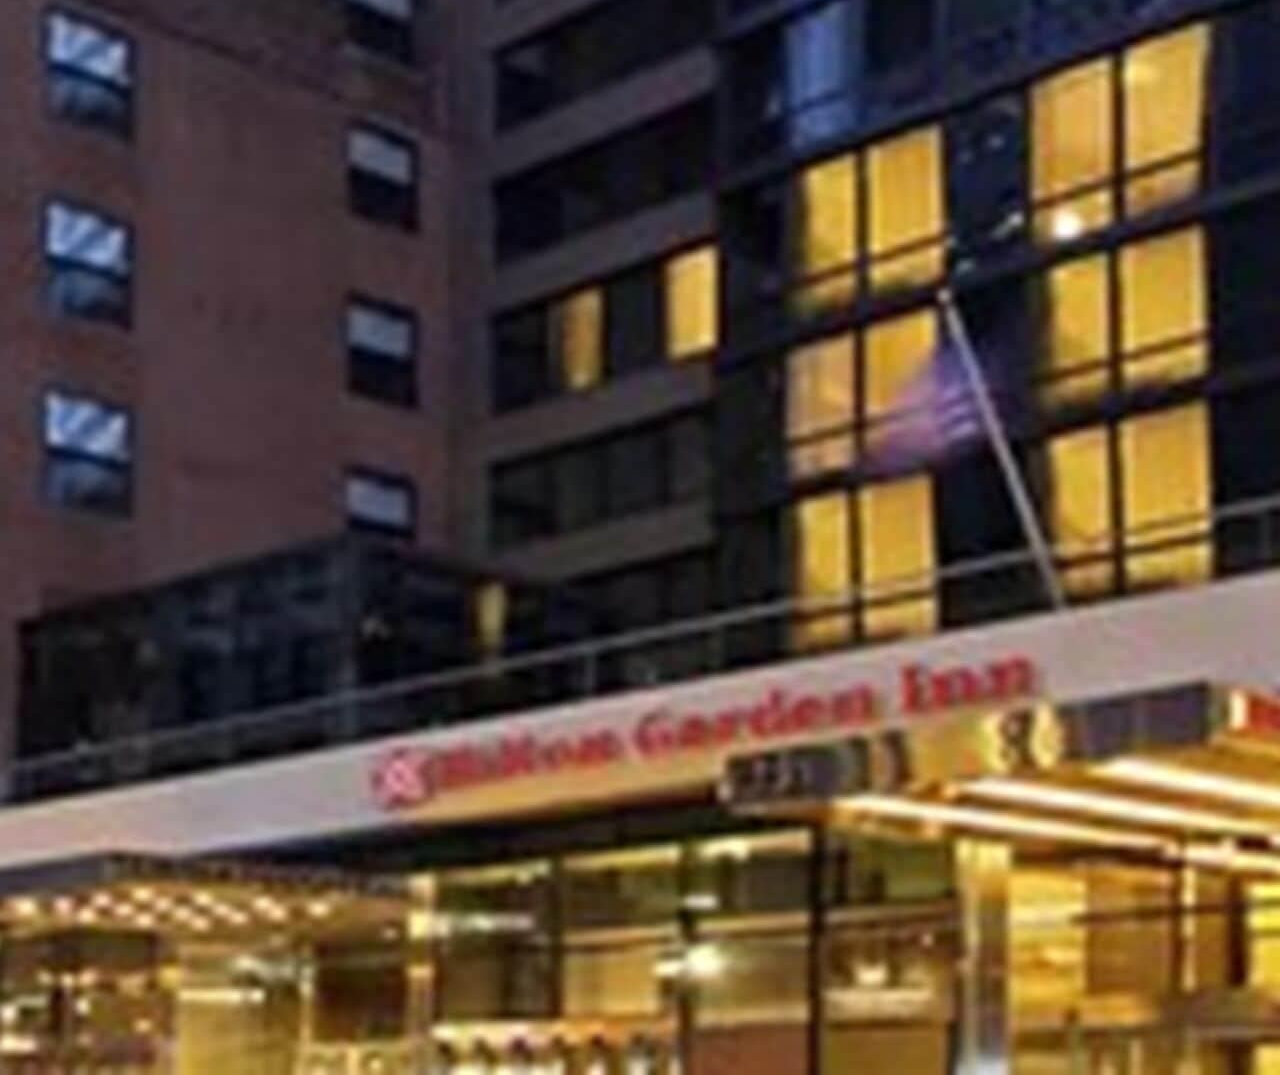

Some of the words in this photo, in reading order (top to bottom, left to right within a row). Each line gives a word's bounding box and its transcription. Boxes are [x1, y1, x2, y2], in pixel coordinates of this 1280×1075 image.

[434, 729, 622, 793] Hilton
[633, 686, 875, 757] Garden
[899, 656, 1033, 712] Inn
